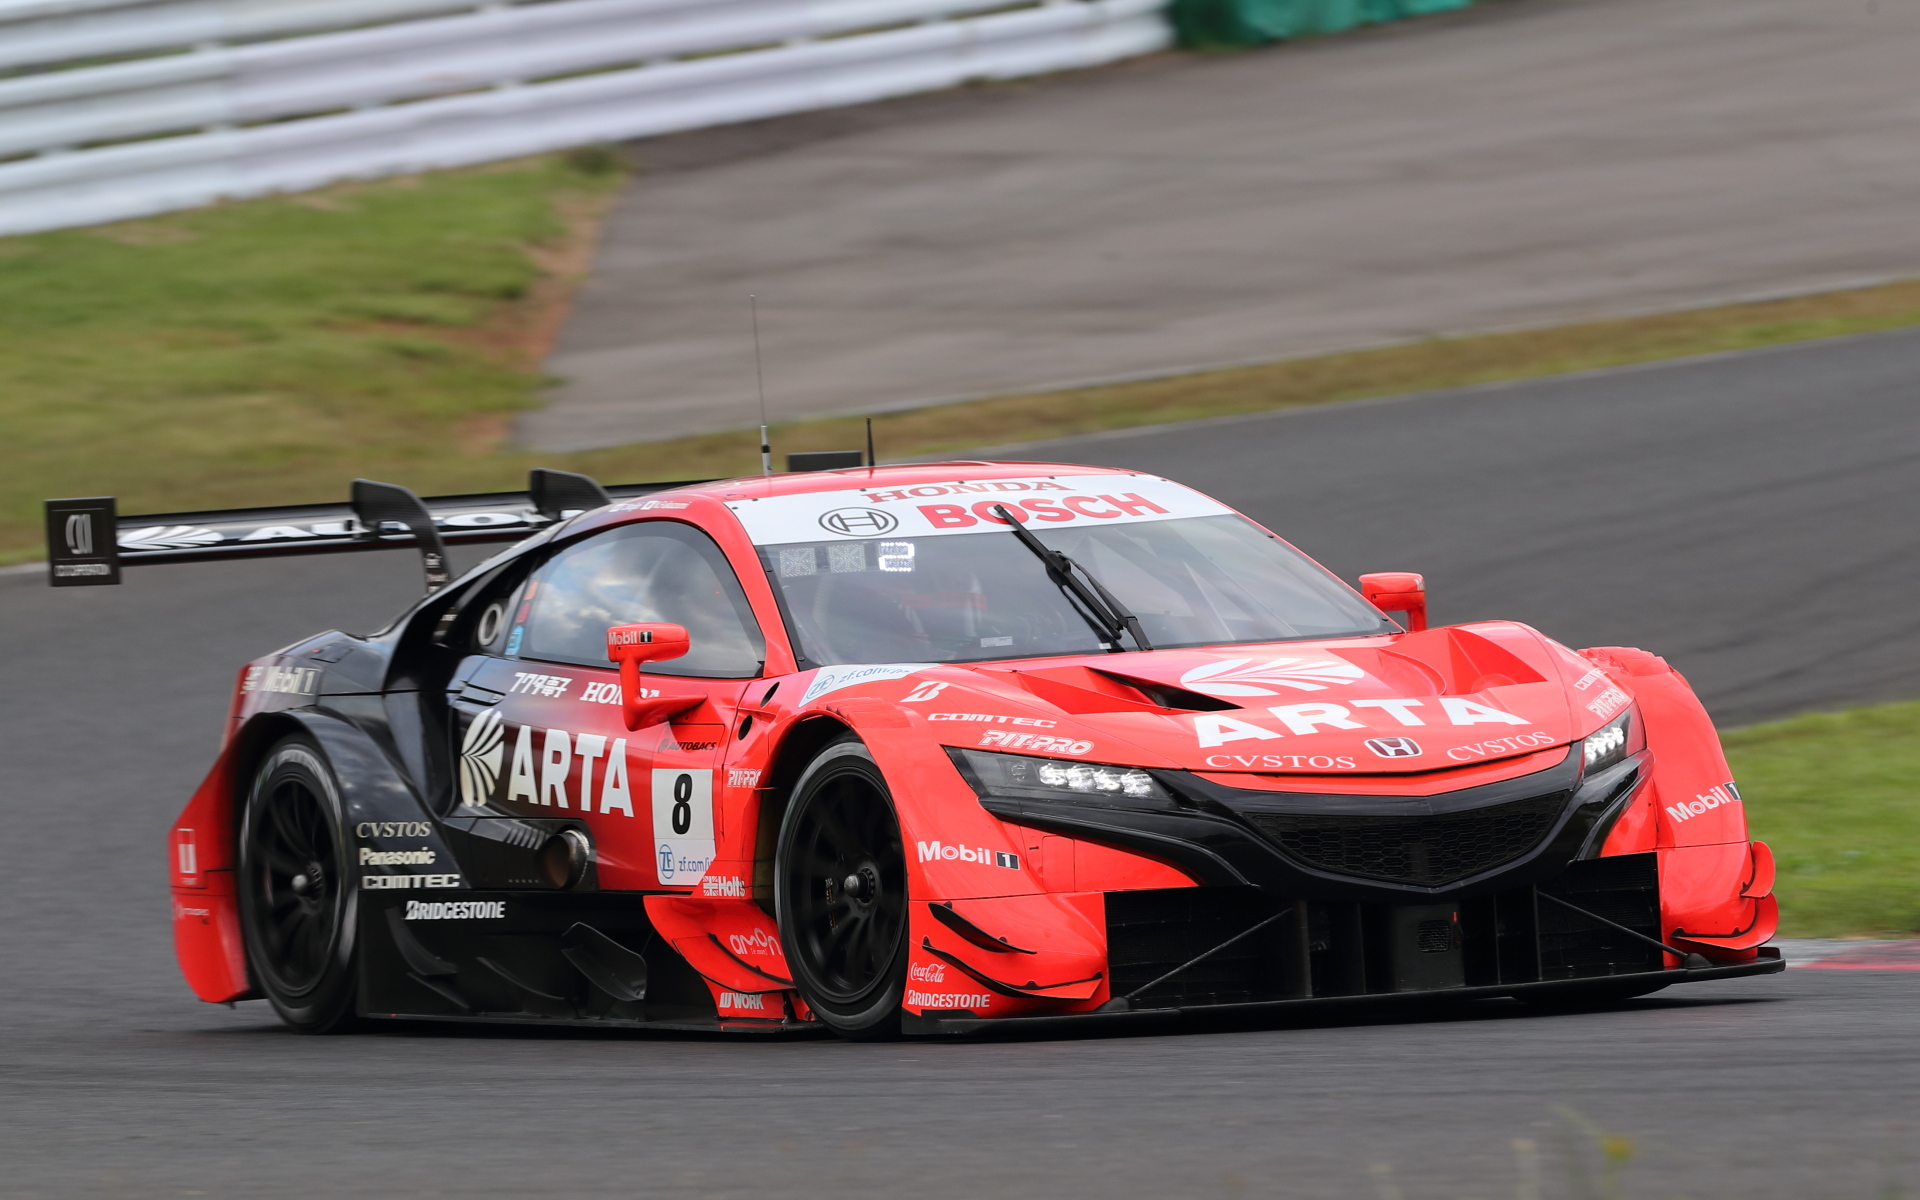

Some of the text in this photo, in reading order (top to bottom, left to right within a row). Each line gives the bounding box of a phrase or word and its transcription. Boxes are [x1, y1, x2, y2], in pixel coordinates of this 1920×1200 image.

[864, 480, 1076, 504] HONDA
[916, 492, 1171, 528] BOSCH
[608, 631, 651, 645] Mobil 1
[927, 713, 1057, 729] COMTEC
[1194, 697, 1533, 749] ARTA
[667, 741, 717, 751] AUTOBACS
[1446, 731, 1556, 763] CVSTOS
[508, 725, 635, 818] ARTA
[1206, 754, 1357, 770] CVSTOS
[671, 773, 693, 835] 8
[1665, 782, 1742, 823] Mobil 1
[356, 821, 432, 838] CVSTOS
[359, 847, 436, 866] Panasonic
[918, 841, 1014, 869] Mobil 1
[362, 874, 461, 889] COMTEC
[718, 876, 746, 897] Holts
[405, 900, 506, 920] BRIDGESTONE
[729, 928, 783, 956] amon
[732, 993, 765, 1010] WORK
[907, 989, 991, 1008] BRIDGESTONE
